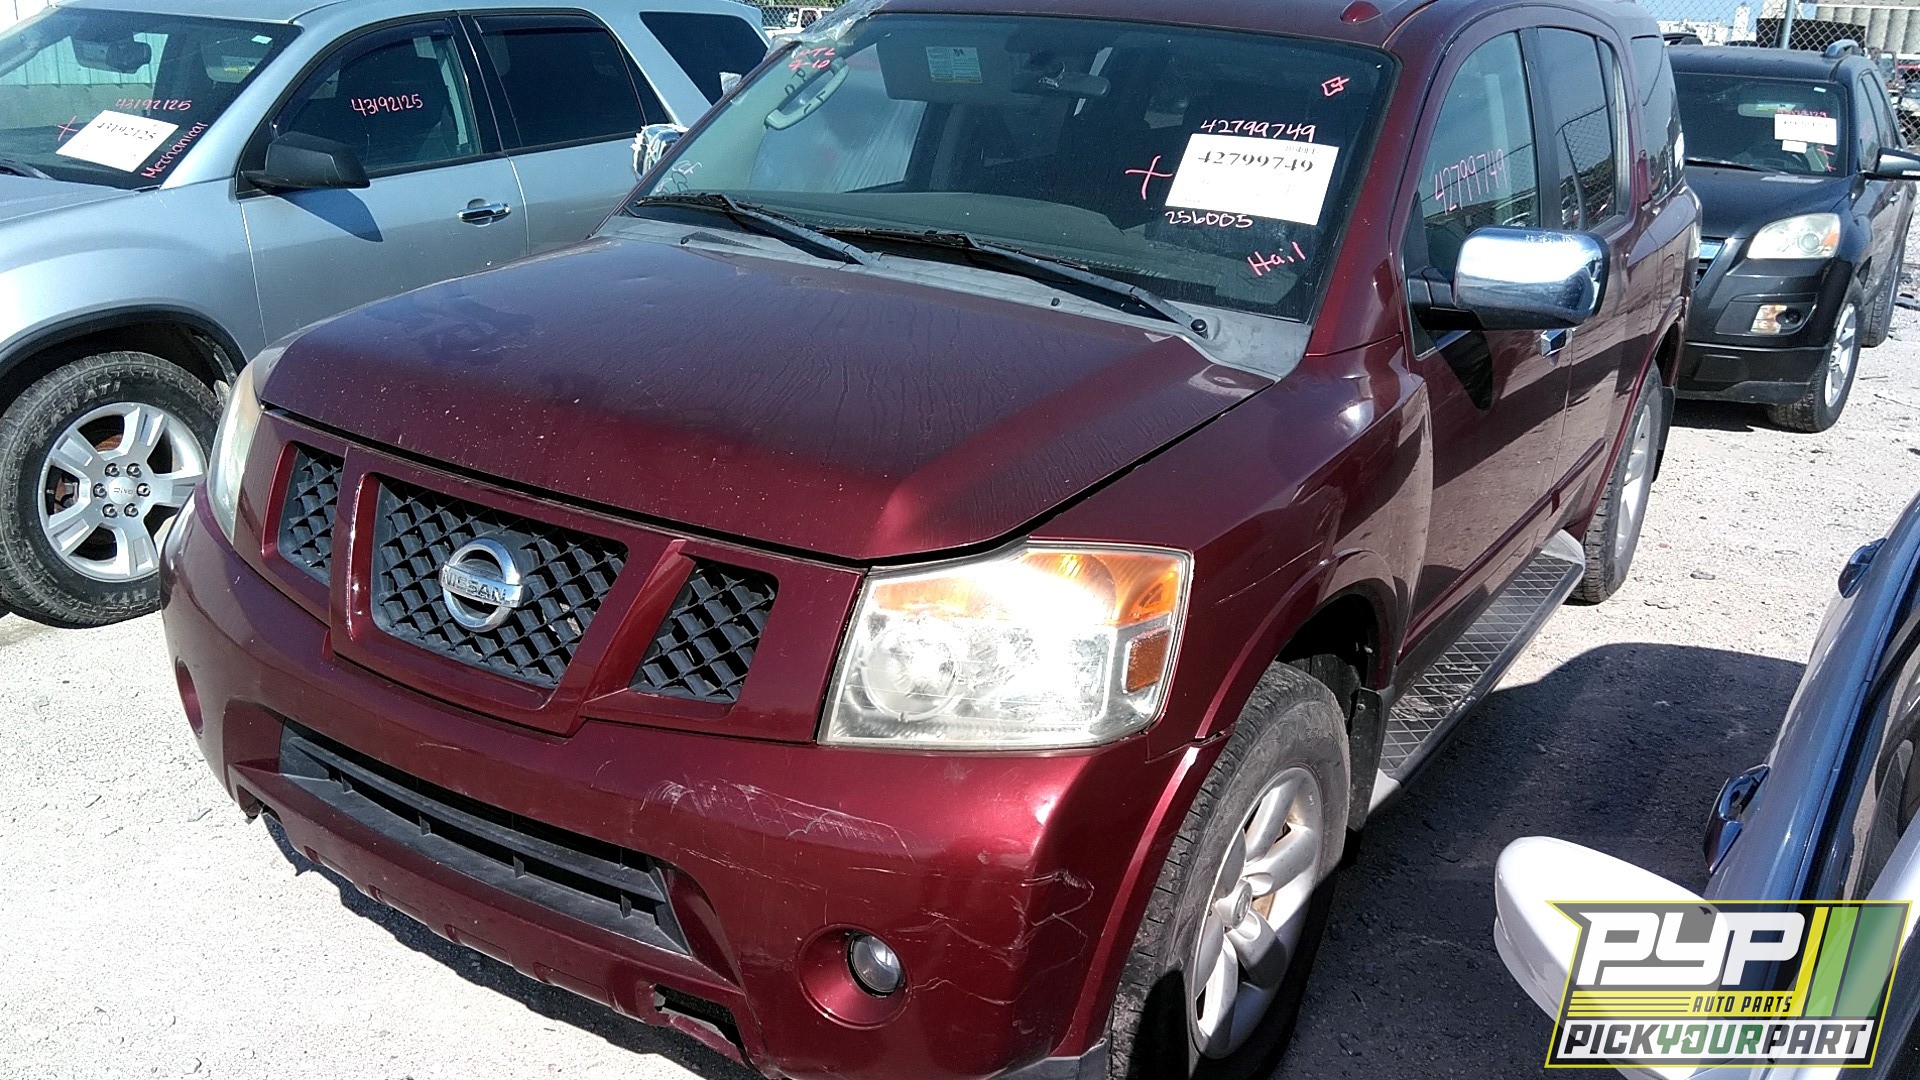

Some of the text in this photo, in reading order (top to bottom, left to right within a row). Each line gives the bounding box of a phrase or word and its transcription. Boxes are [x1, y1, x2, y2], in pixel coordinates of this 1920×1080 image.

[115, 98, 192, 111] 43192125
[351, 94, 423, 116] 43192125
[1201, 119, 1316, 142] 42799749
[141, 121, 208, 179] Mechanical
[1198, 151, 1314, 172] 42799749
[1434, 148, 1508, 216] 42799749
[1164, 210, 1254, 228] 256005
[1247, 241, 1306, 276] Hail
[442, 568, 507, 602] NISSAN
